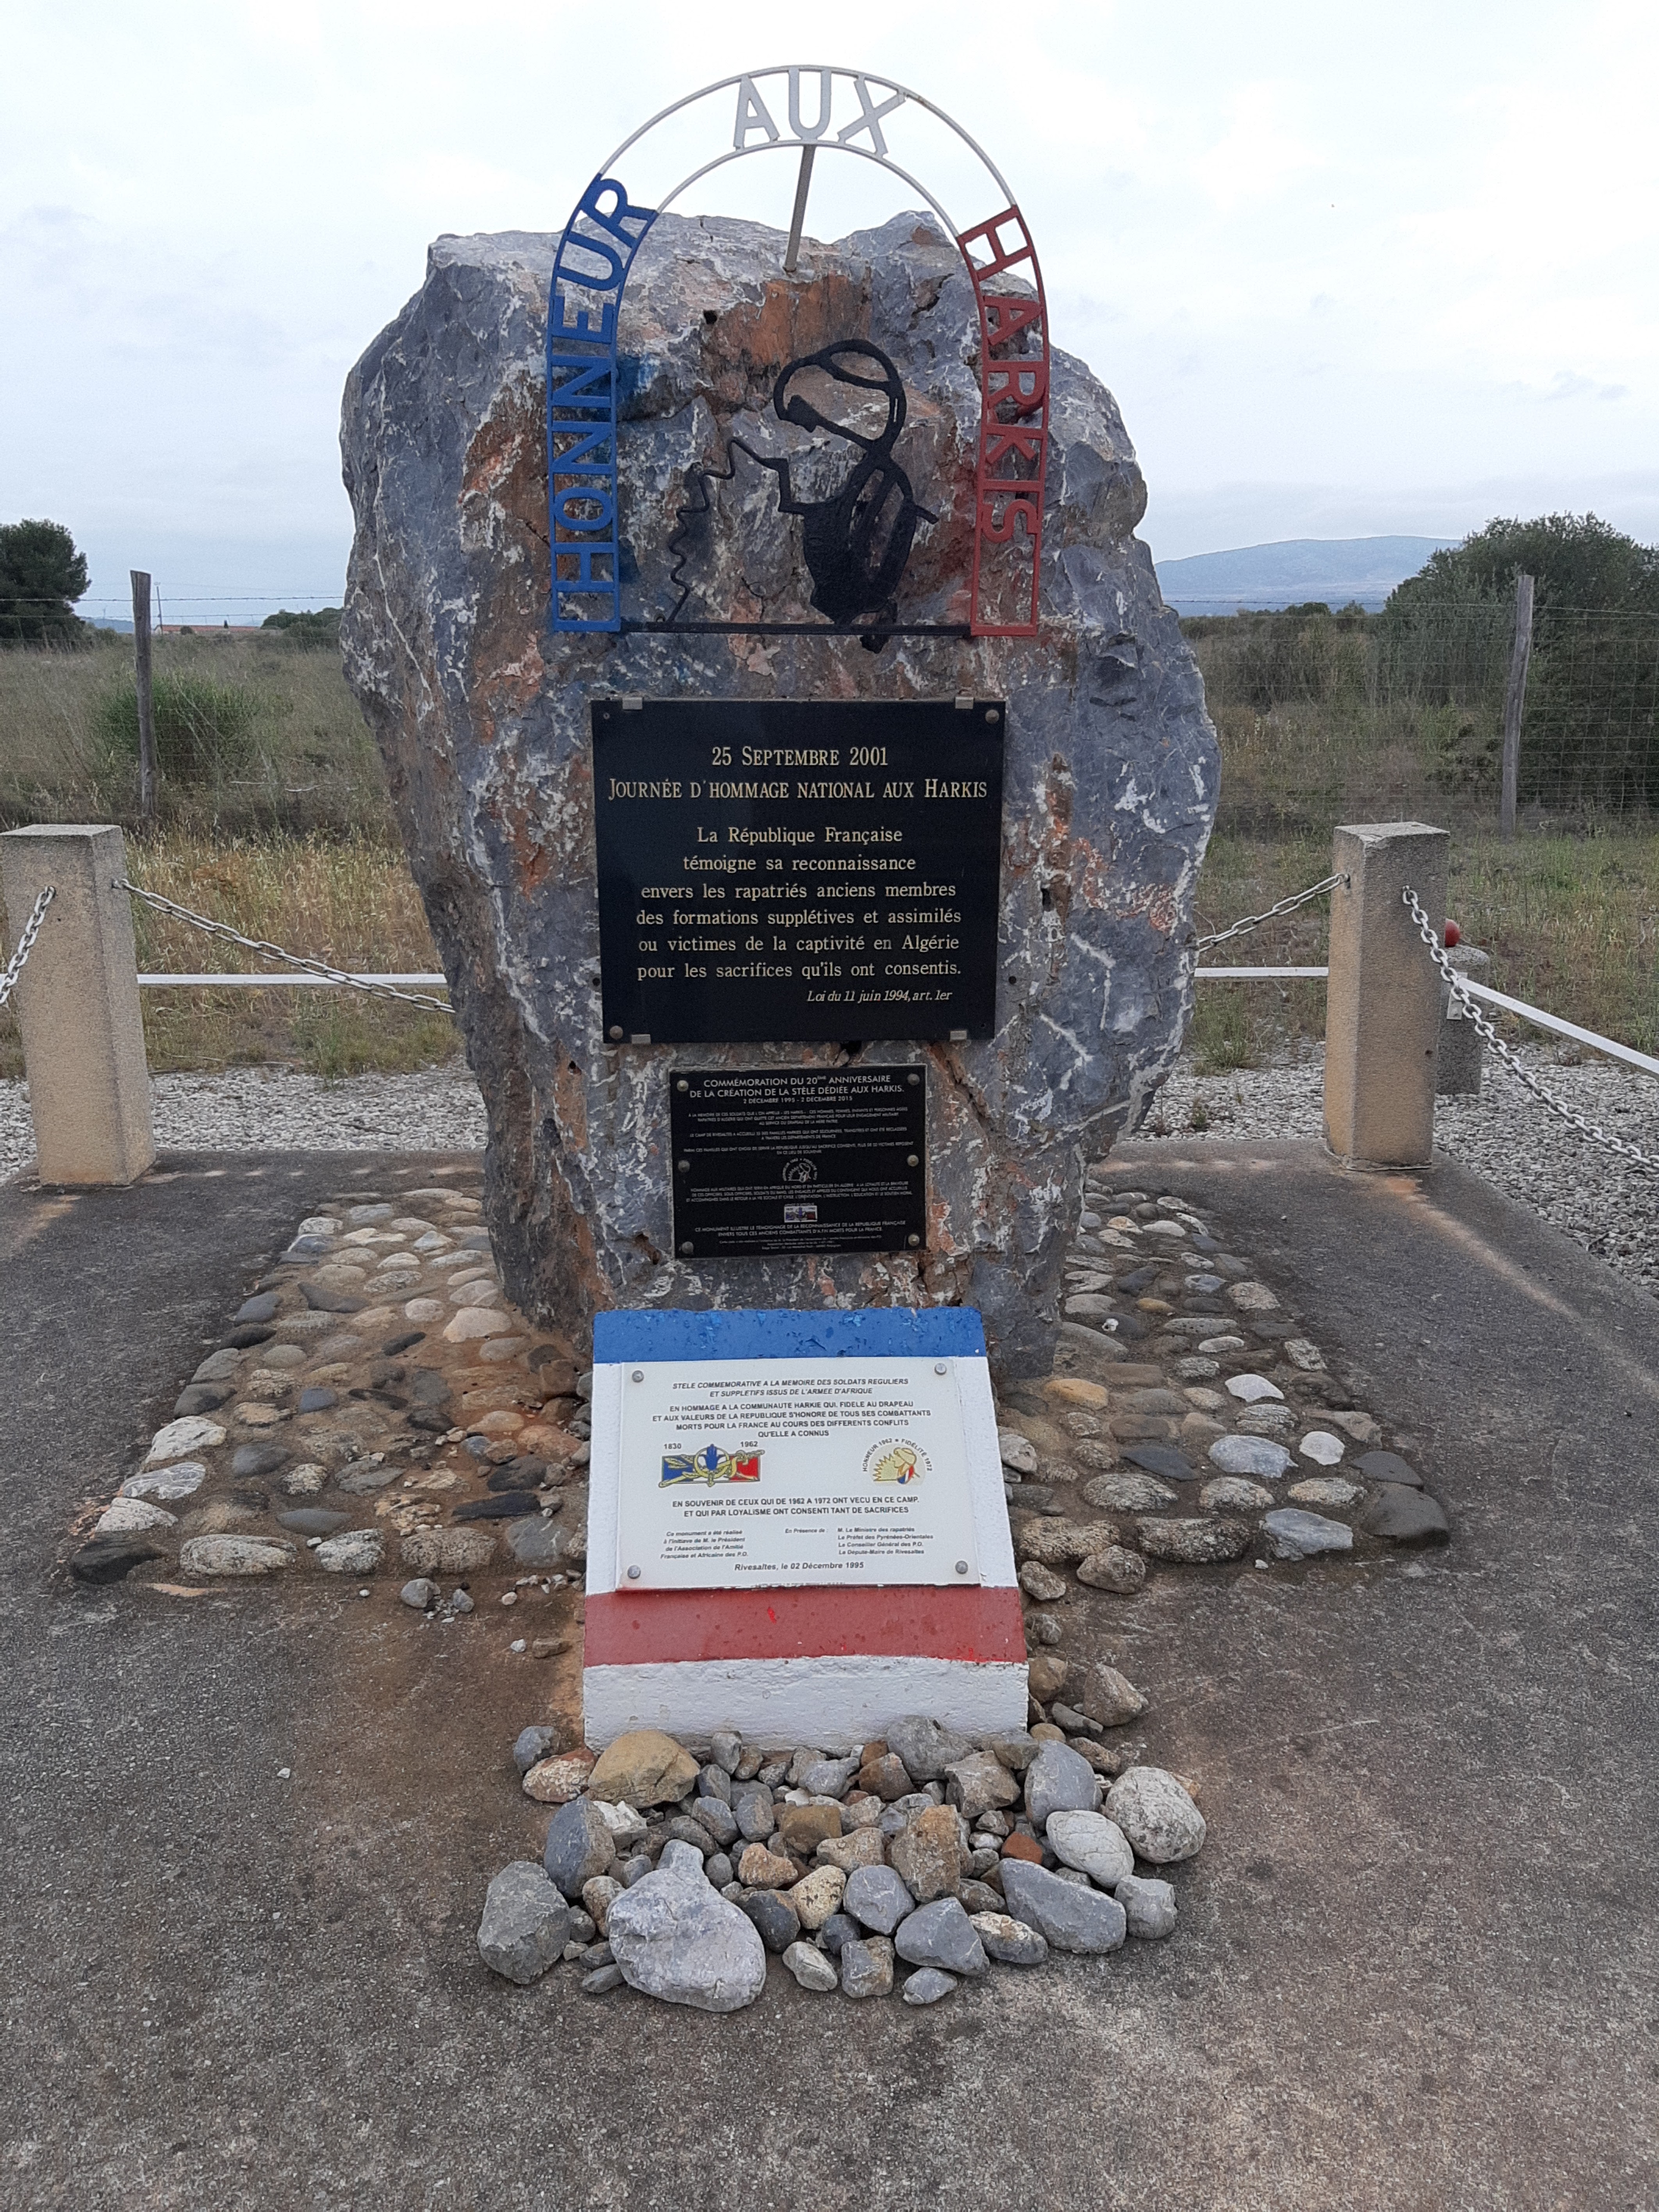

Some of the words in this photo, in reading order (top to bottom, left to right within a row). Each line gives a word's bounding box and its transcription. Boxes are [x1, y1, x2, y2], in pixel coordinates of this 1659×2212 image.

[548, 176, 658, 593] HONNEUR
[733, 65, 906, 155] AUX
[958, 205, 1050, 546] HARKIS
[712, 747, 731, 765] 25
[850, 747, 888, 765] 2001
[883, 782, 913, 798] AUX
[697, 827, 717, 842] La
[728, 827, 815, 846] République
[825, 826, 902, 845] Française
[683, 854, 756, 873] témoigne
[766, 859, 783, 870] sa
[792, 854, 915, 870] reconnaissance
[642, 887, 693, 898] envers
[703, 883, 725, 898] les
[735, 883, 806, 901] rapatriés
[817, 882, 875, 897] anciens
[885, 881, 956, 896] membres
[637, 910, 663, 924] des
[673, 909, 758, 924] formations
[768, 909, 854, 927] supplétives
[863, 911, 878, 923] et
[888, 908, 961, 923] assimilés
[639, 941, 657, 951] ou
[667, 936, 736, 951] victimes
[746, 936, 763, 951] de
[774, 936, 786, 951] la
[796, 935, 864, 953] captivité
[874, 939, 892, 949] en
[902, 934, 959, 953] Algérie
[638, 967, 675, 981] pour
[685, 963, 706, 977] les
[717, 962, 792, 977] sacrifices
[802, 962, 841, 979] qu'ils
[851, 963, 875, 976] ont
[885, 960, 960, 975] consentis.
[807, 990, 826, 1001] Loi
[828, 990, 841, 1001] du
[858, 990, 881, 1003] juin
[883, 990, 910, 1002] 1994,
[913, 992, 932, 1001] art.
[829, 1075, 890, 1084] ANNIVERSAIRE
[717, 1088, 761, 1097] CRÉATION
[792, 1086, 815, 1095] STÈLE
[818, 1085, 848, 1094] DÉDIÉE
